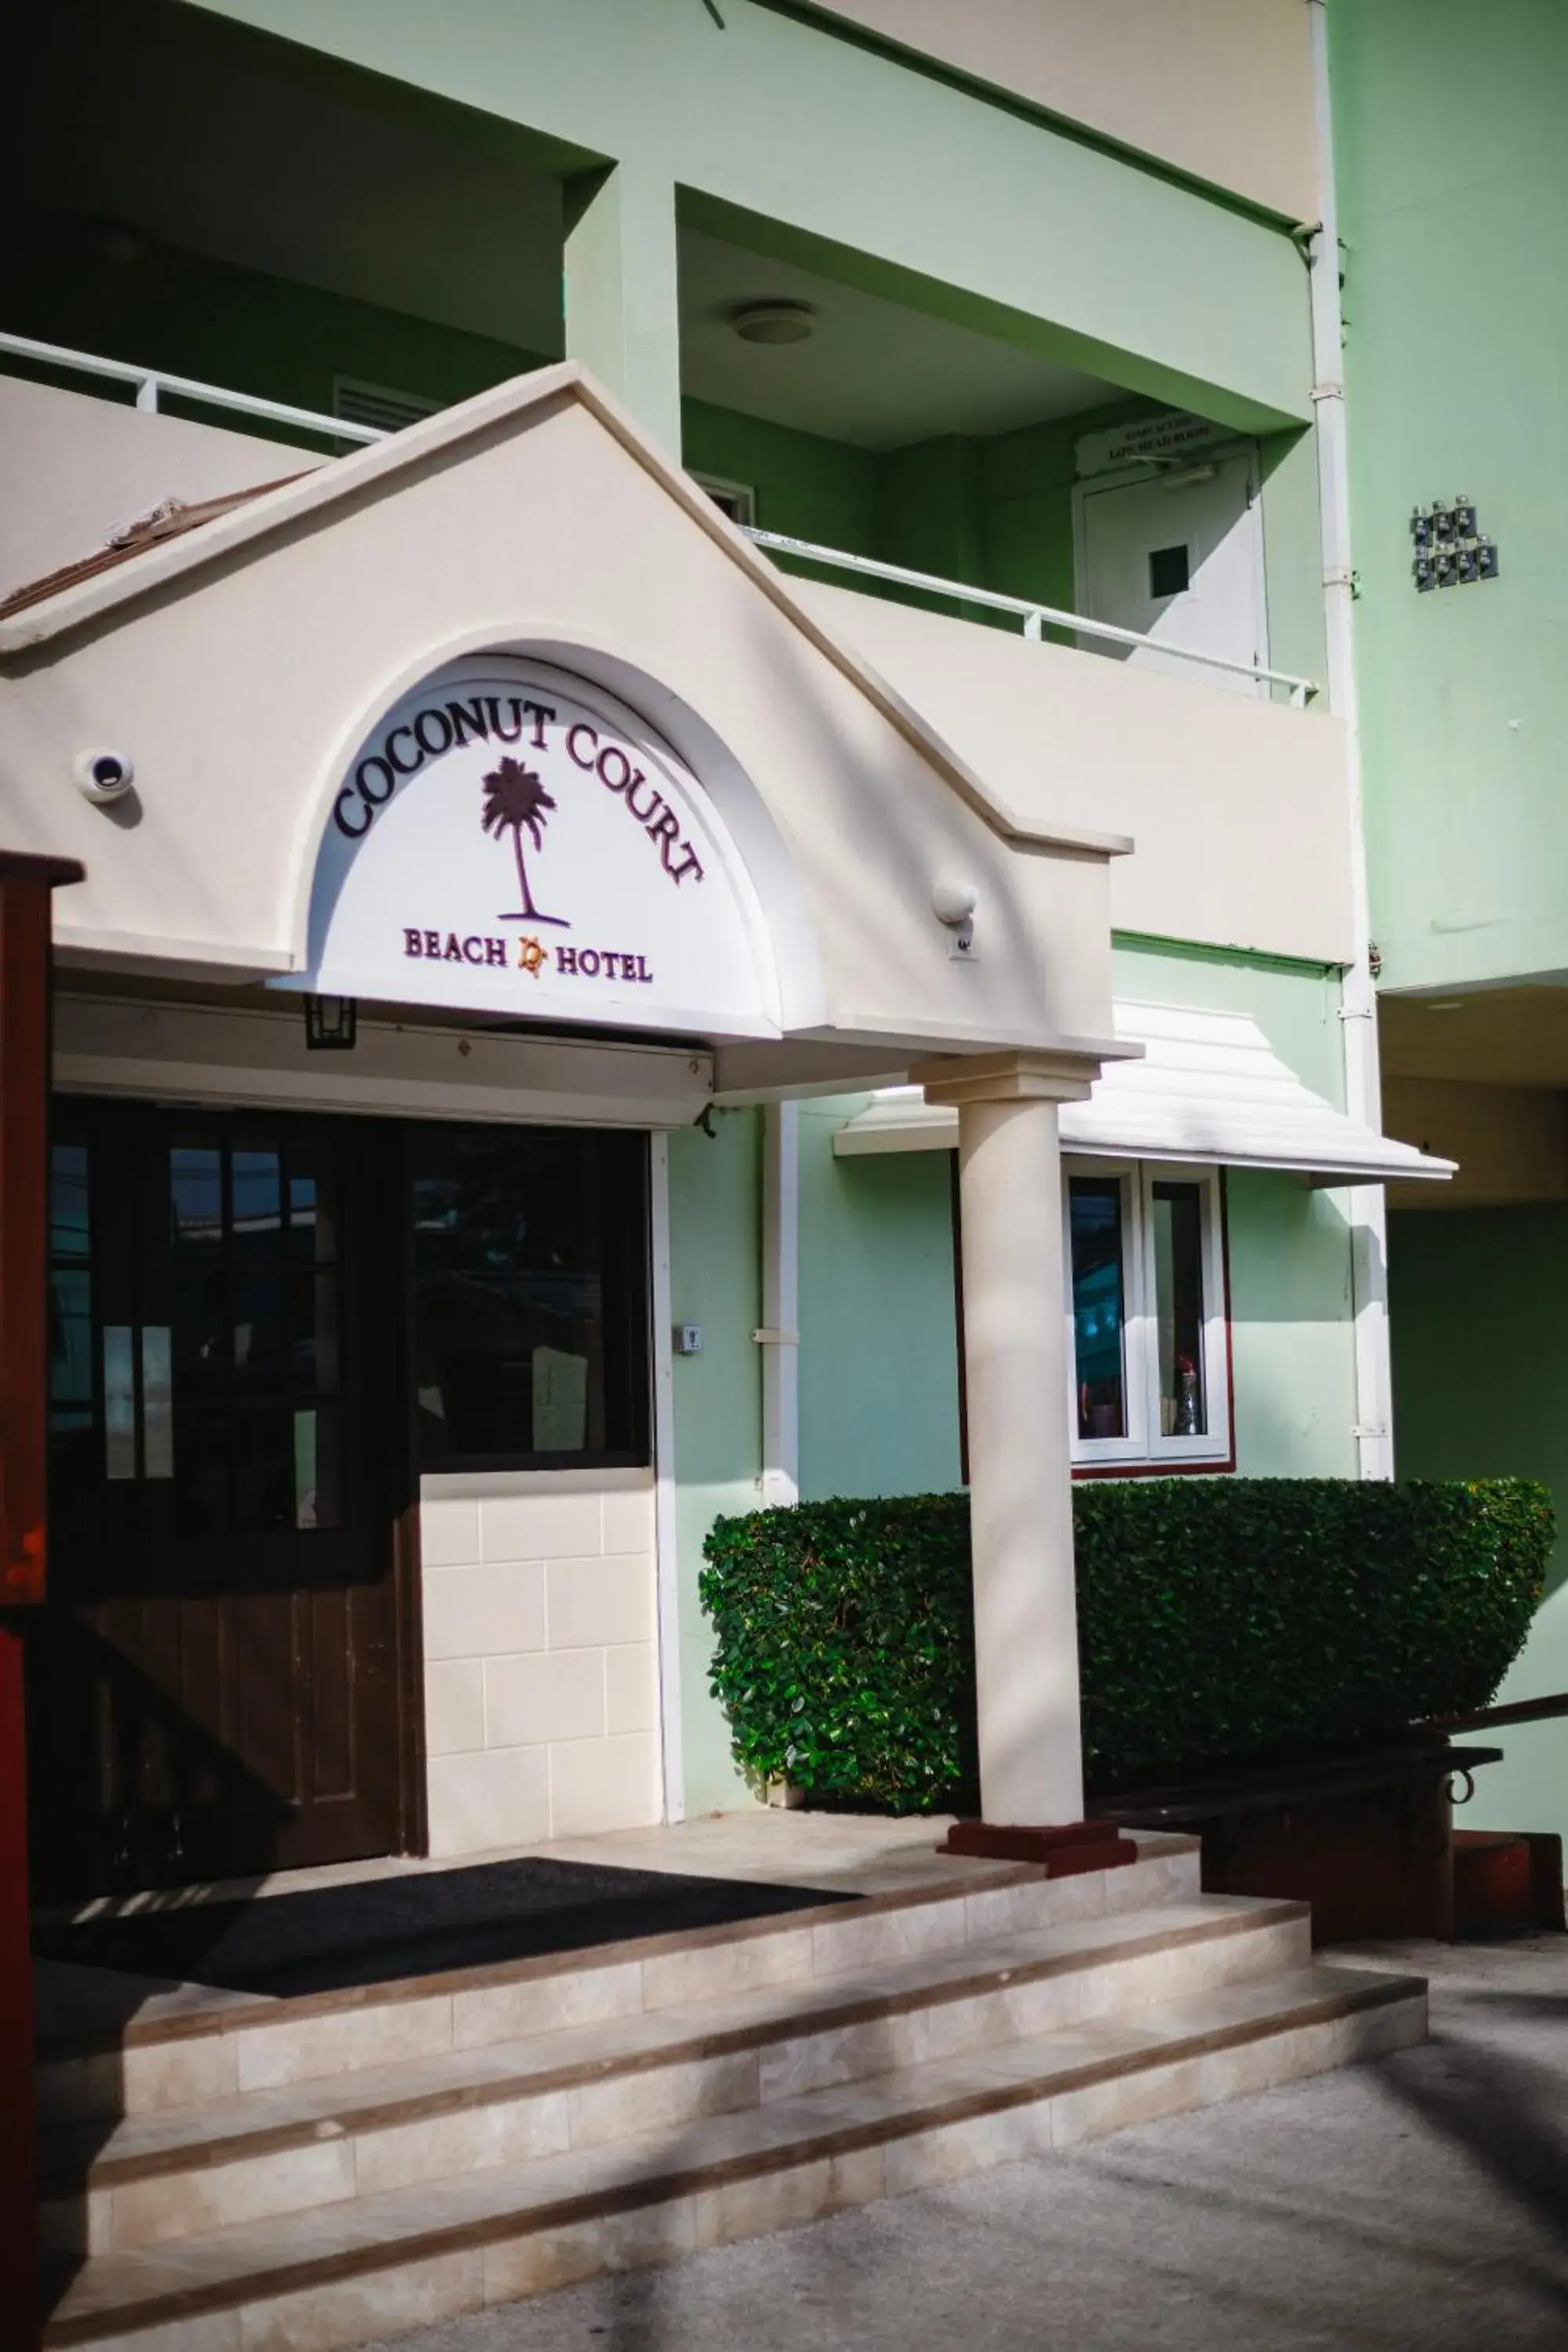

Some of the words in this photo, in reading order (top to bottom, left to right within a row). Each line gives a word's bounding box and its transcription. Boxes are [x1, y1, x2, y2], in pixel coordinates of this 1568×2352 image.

[332, 696, 555, 839] COCONUT
[564, 723, 704, 886] COURT
[403, 928, 506, 967] BEACH
[555, 946, 653, 983] HOTEL
